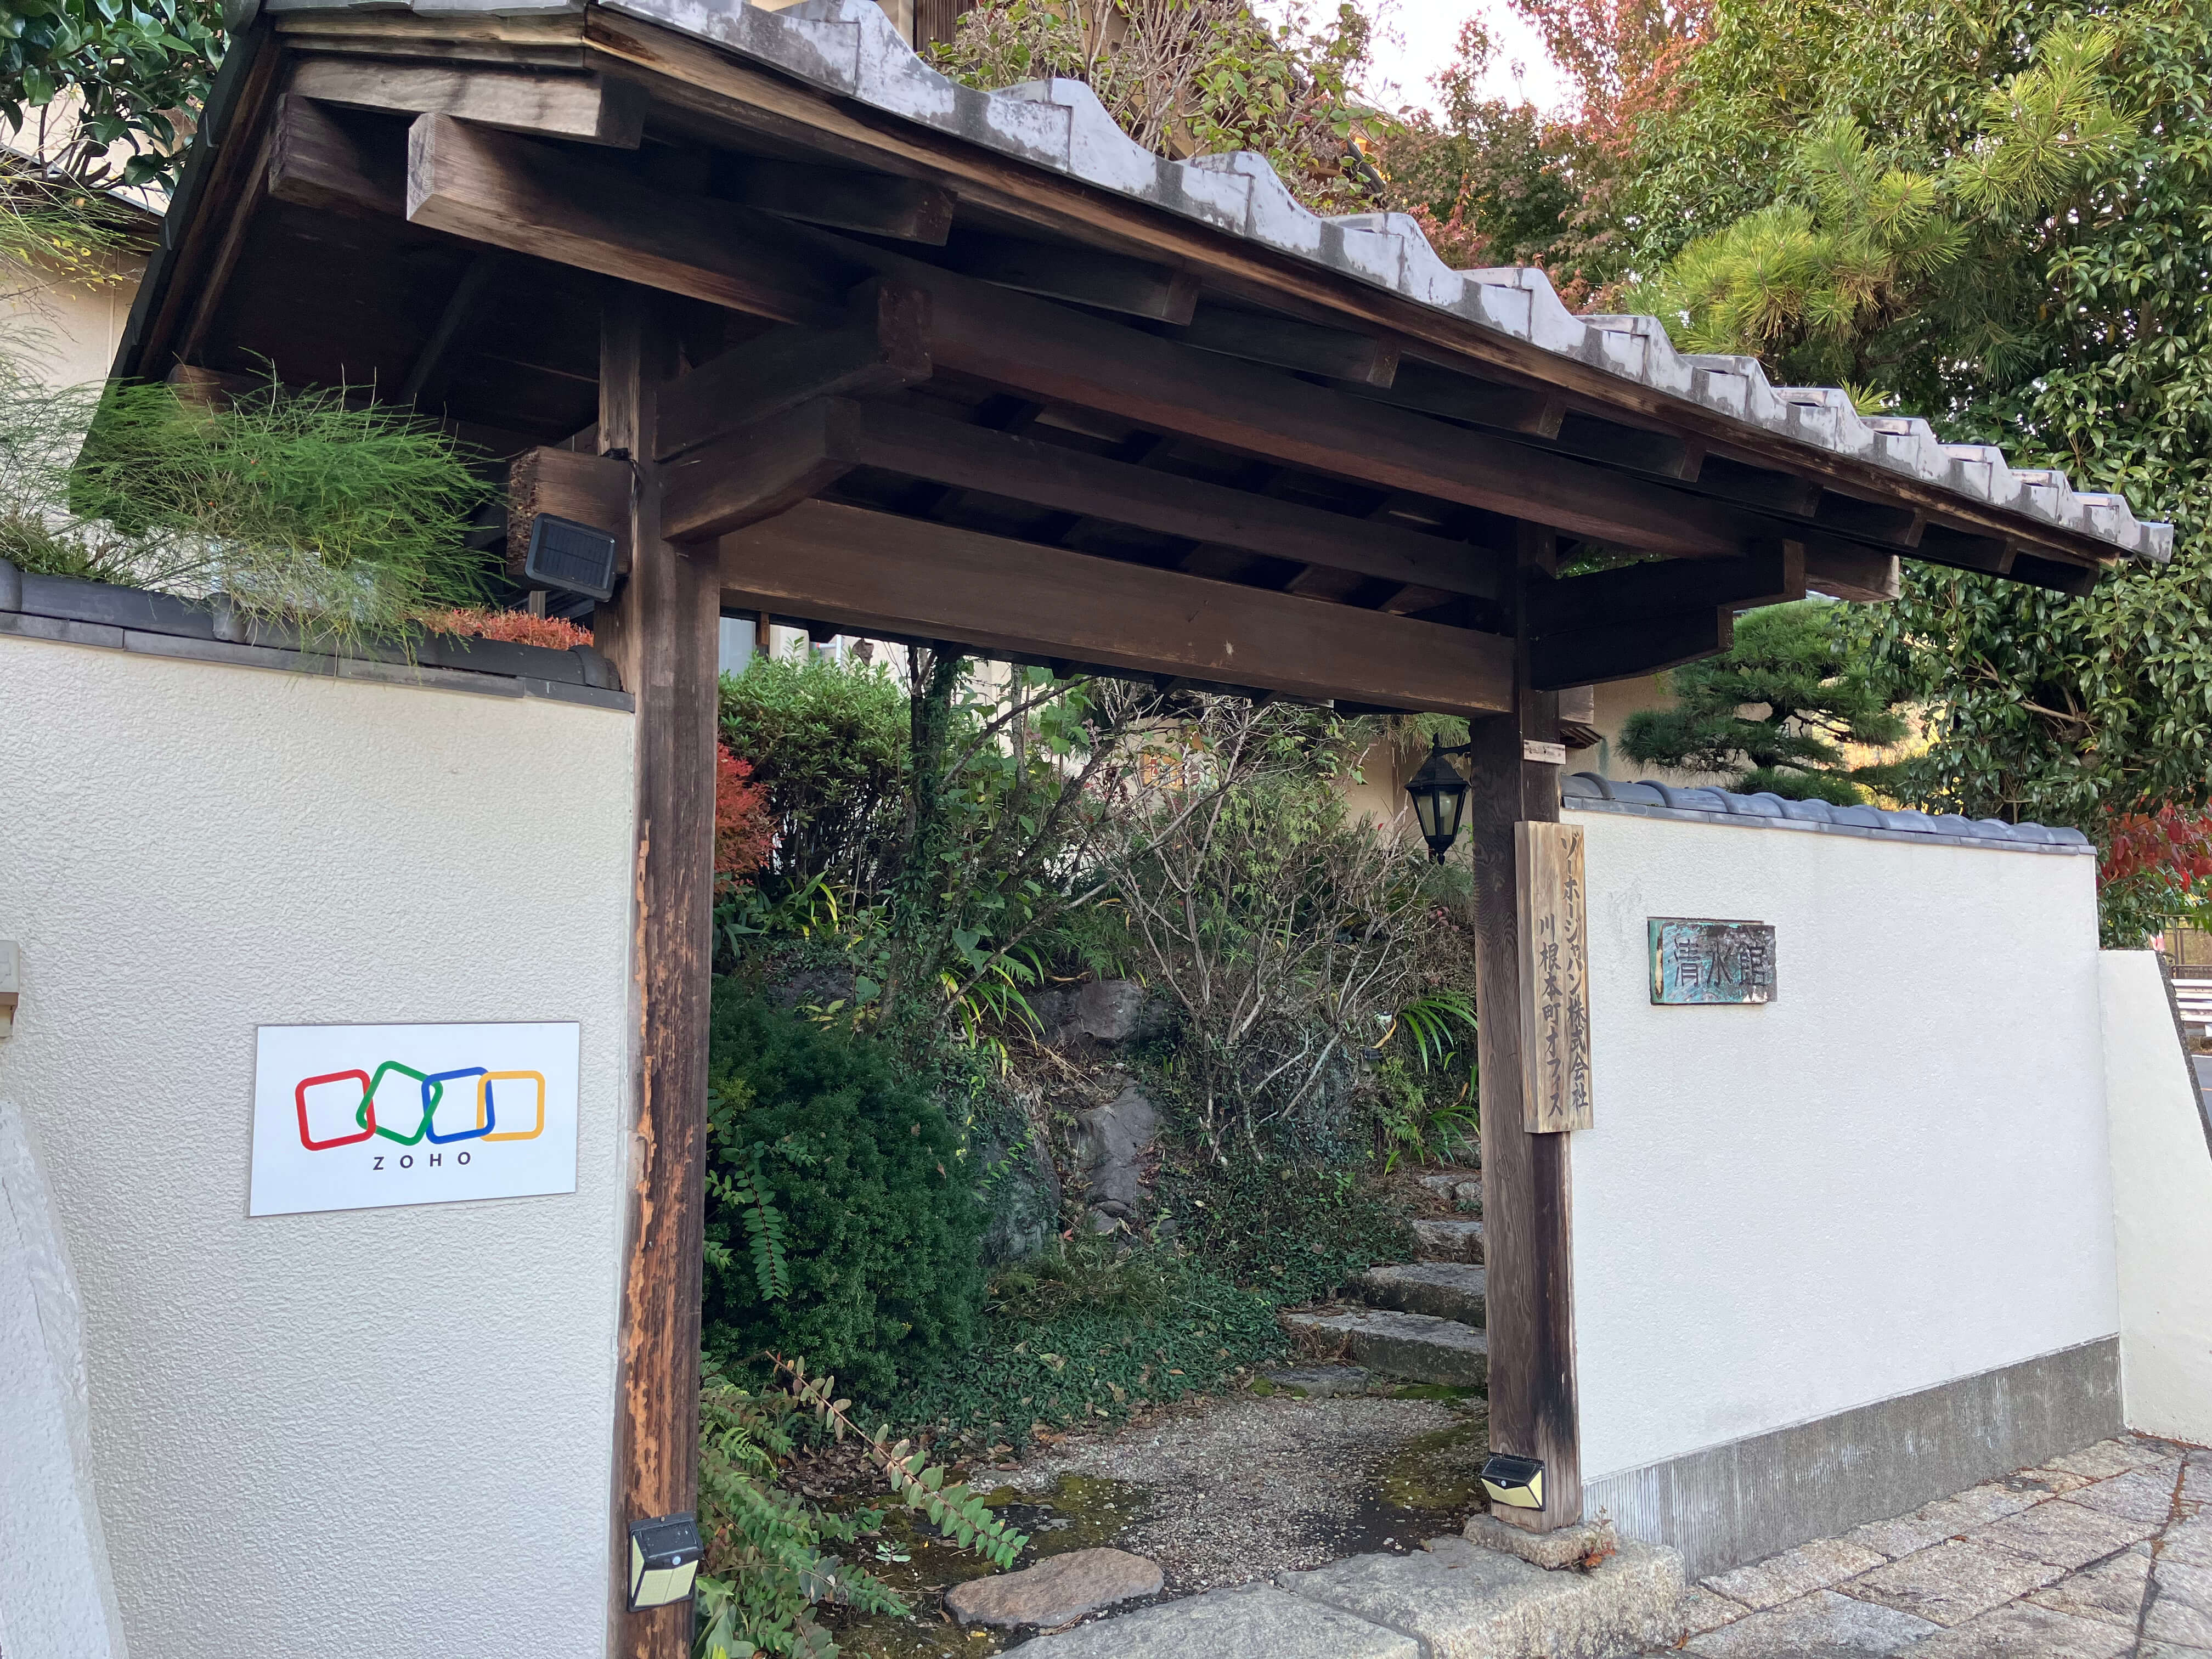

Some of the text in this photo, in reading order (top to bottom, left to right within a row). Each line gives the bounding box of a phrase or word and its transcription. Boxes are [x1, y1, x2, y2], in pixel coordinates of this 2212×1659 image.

[1539, 913, 1563, 1117] 川根本町オフィス
[373, 1152, 471, 1171] ZOHO
